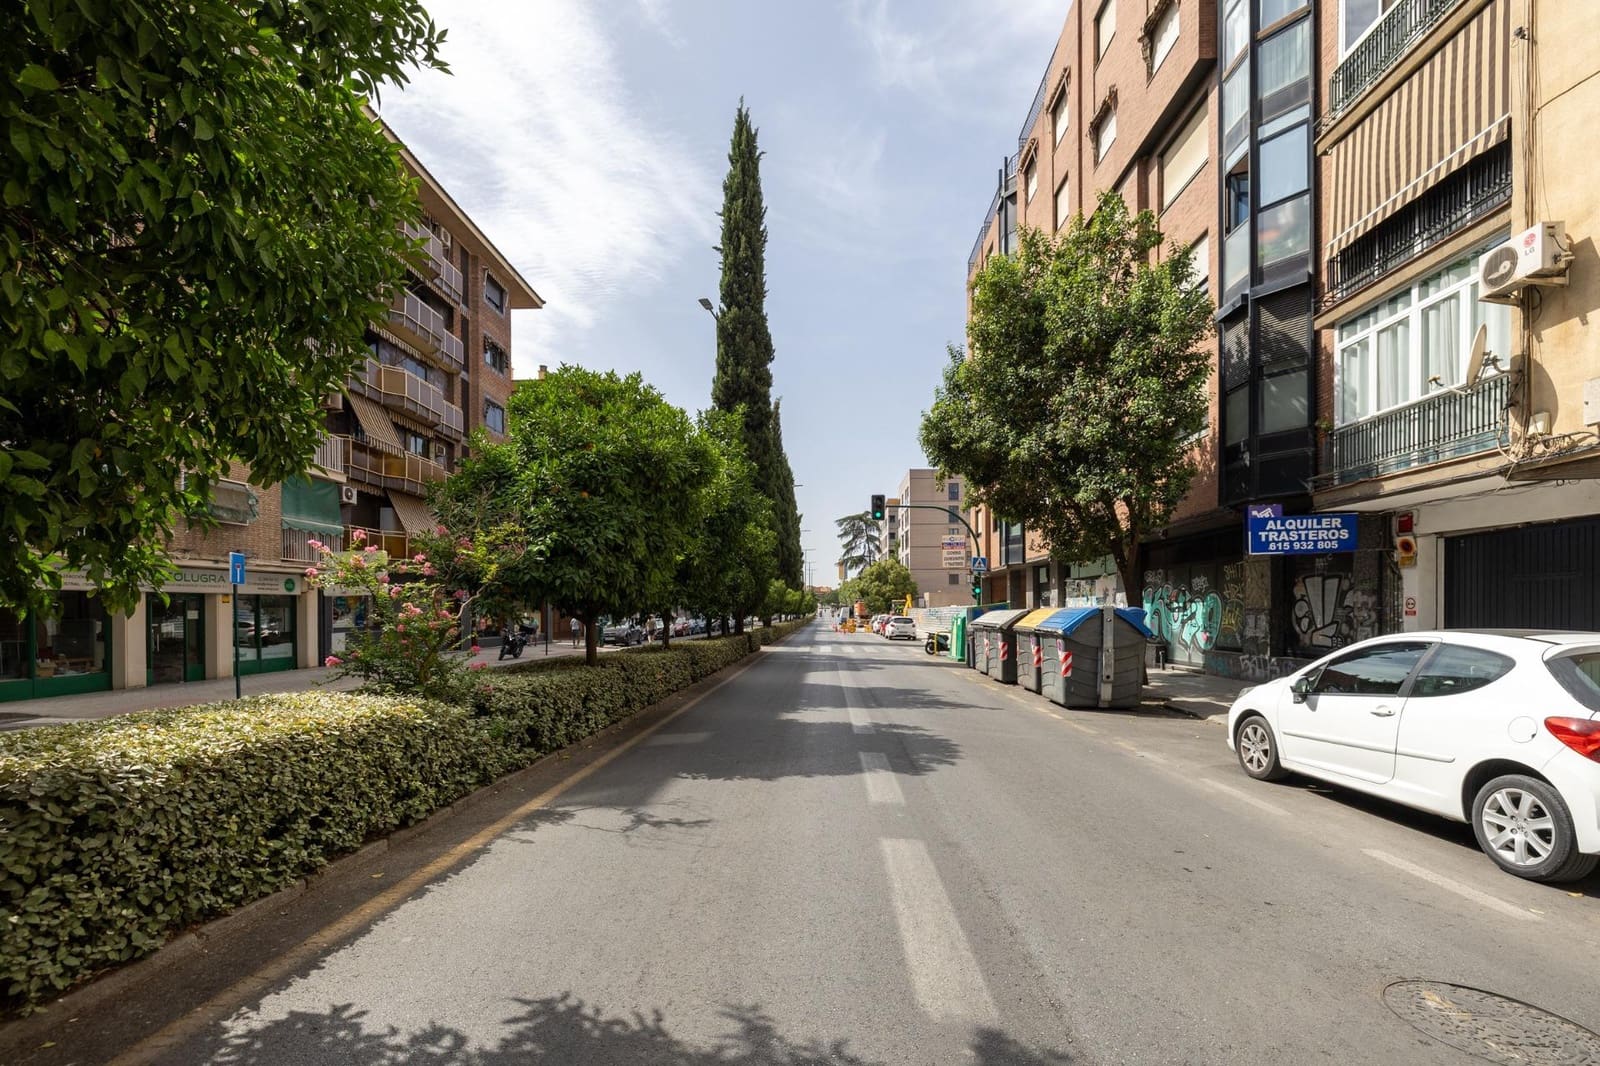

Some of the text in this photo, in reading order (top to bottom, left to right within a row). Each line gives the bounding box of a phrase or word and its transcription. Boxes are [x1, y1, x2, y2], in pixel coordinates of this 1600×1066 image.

[1524, 247, 1535, 256] LG
[1266, 518, 1342, 530] ALQUILER
[1258, 529, 1349, 542] TRASTEROS
[1269, 540, 1338, 550] 615 932 805
[167, 572, 226, 583] OLUGRA
